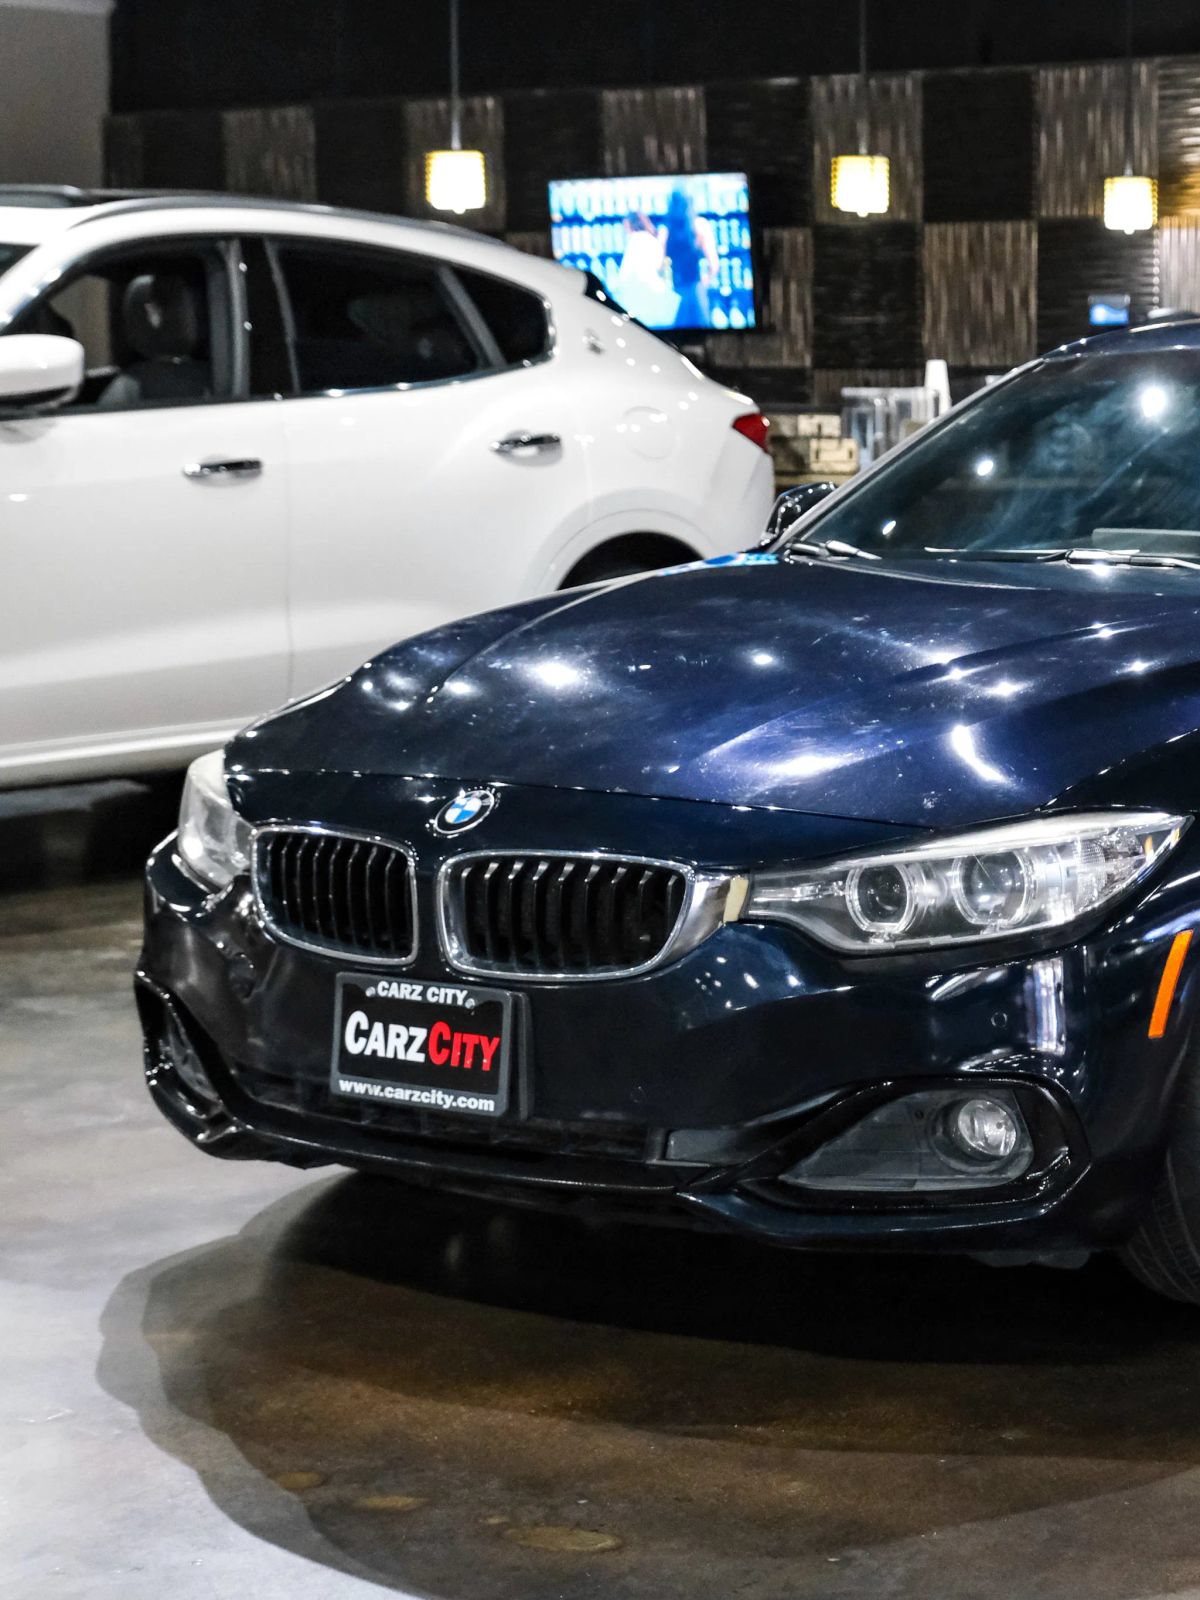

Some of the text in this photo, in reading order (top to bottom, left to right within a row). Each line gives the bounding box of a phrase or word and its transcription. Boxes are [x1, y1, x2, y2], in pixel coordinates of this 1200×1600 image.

[377, 980, 468, 1006] CARZ CITY
[339, 1079, 495, 1111] www.carzcity.com
